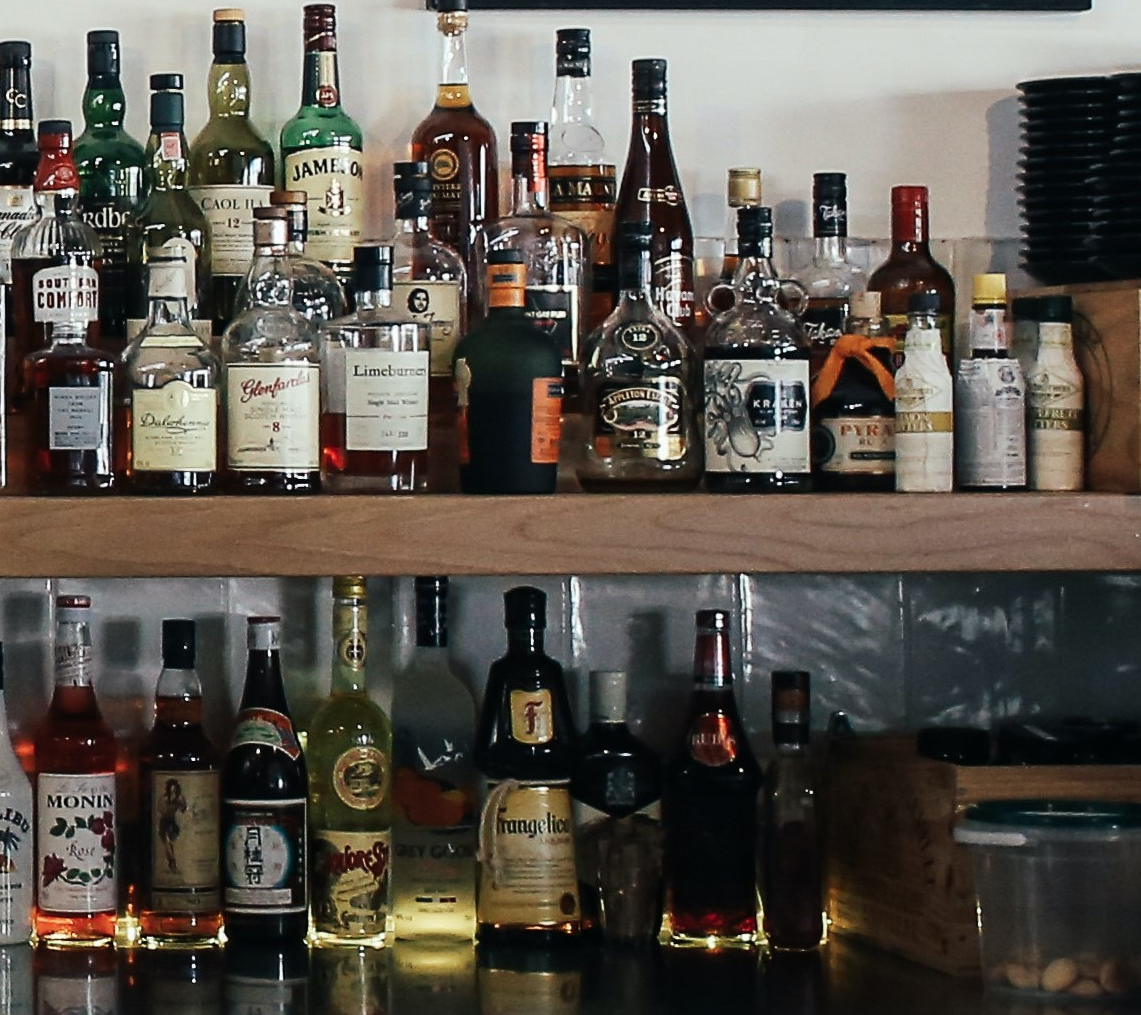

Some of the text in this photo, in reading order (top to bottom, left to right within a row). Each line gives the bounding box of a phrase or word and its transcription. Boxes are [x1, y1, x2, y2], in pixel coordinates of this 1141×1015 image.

[292, 157, 363, 181] JAMEON
[201, 197, 240, 210] CAOL
[227, 217, 240, 229] 12
[272, 421, 280, 432] 8
[47, 794, 113, 809] MONIN
